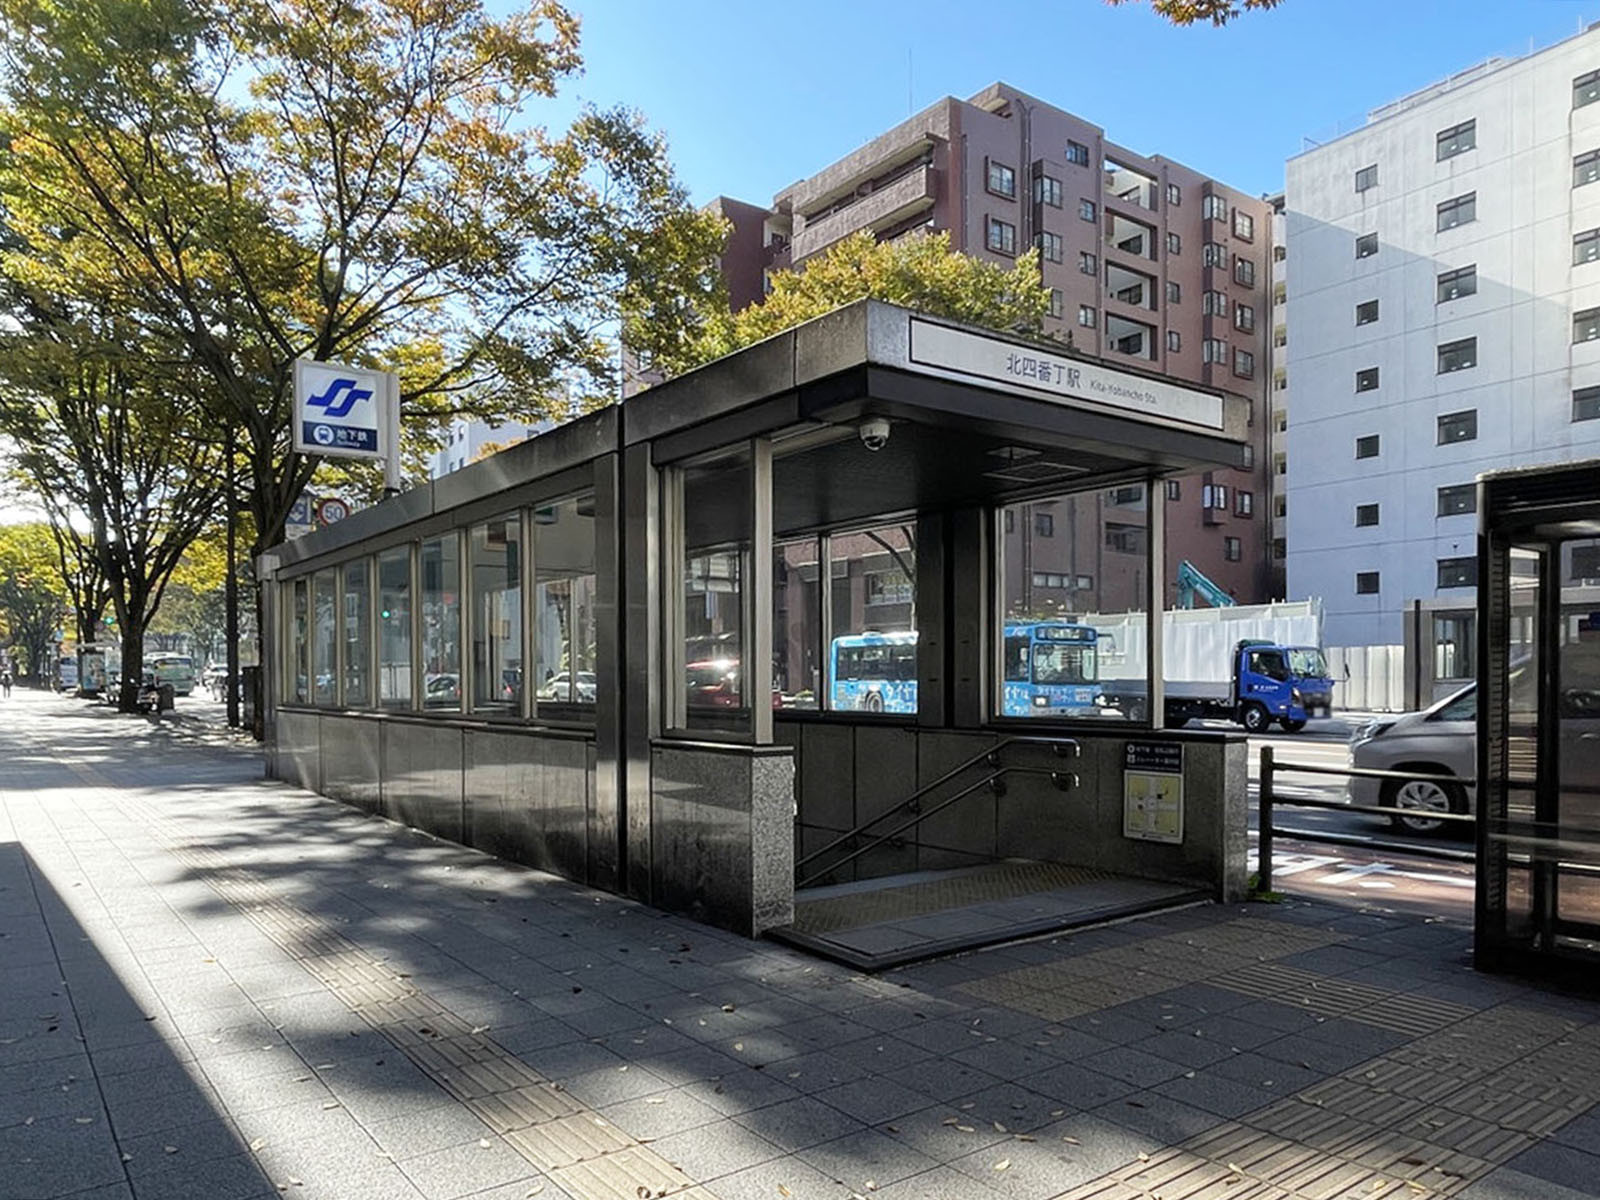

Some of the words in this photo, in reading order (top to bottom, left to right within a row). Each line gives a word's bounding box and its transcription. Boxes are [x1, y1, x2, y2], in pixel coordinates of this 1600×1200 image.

[1006, 352, 1081, 389] 北四番丁駅
[336, 428, 368, 442] 地下鉄
[325, 505, 343, 521] 50
